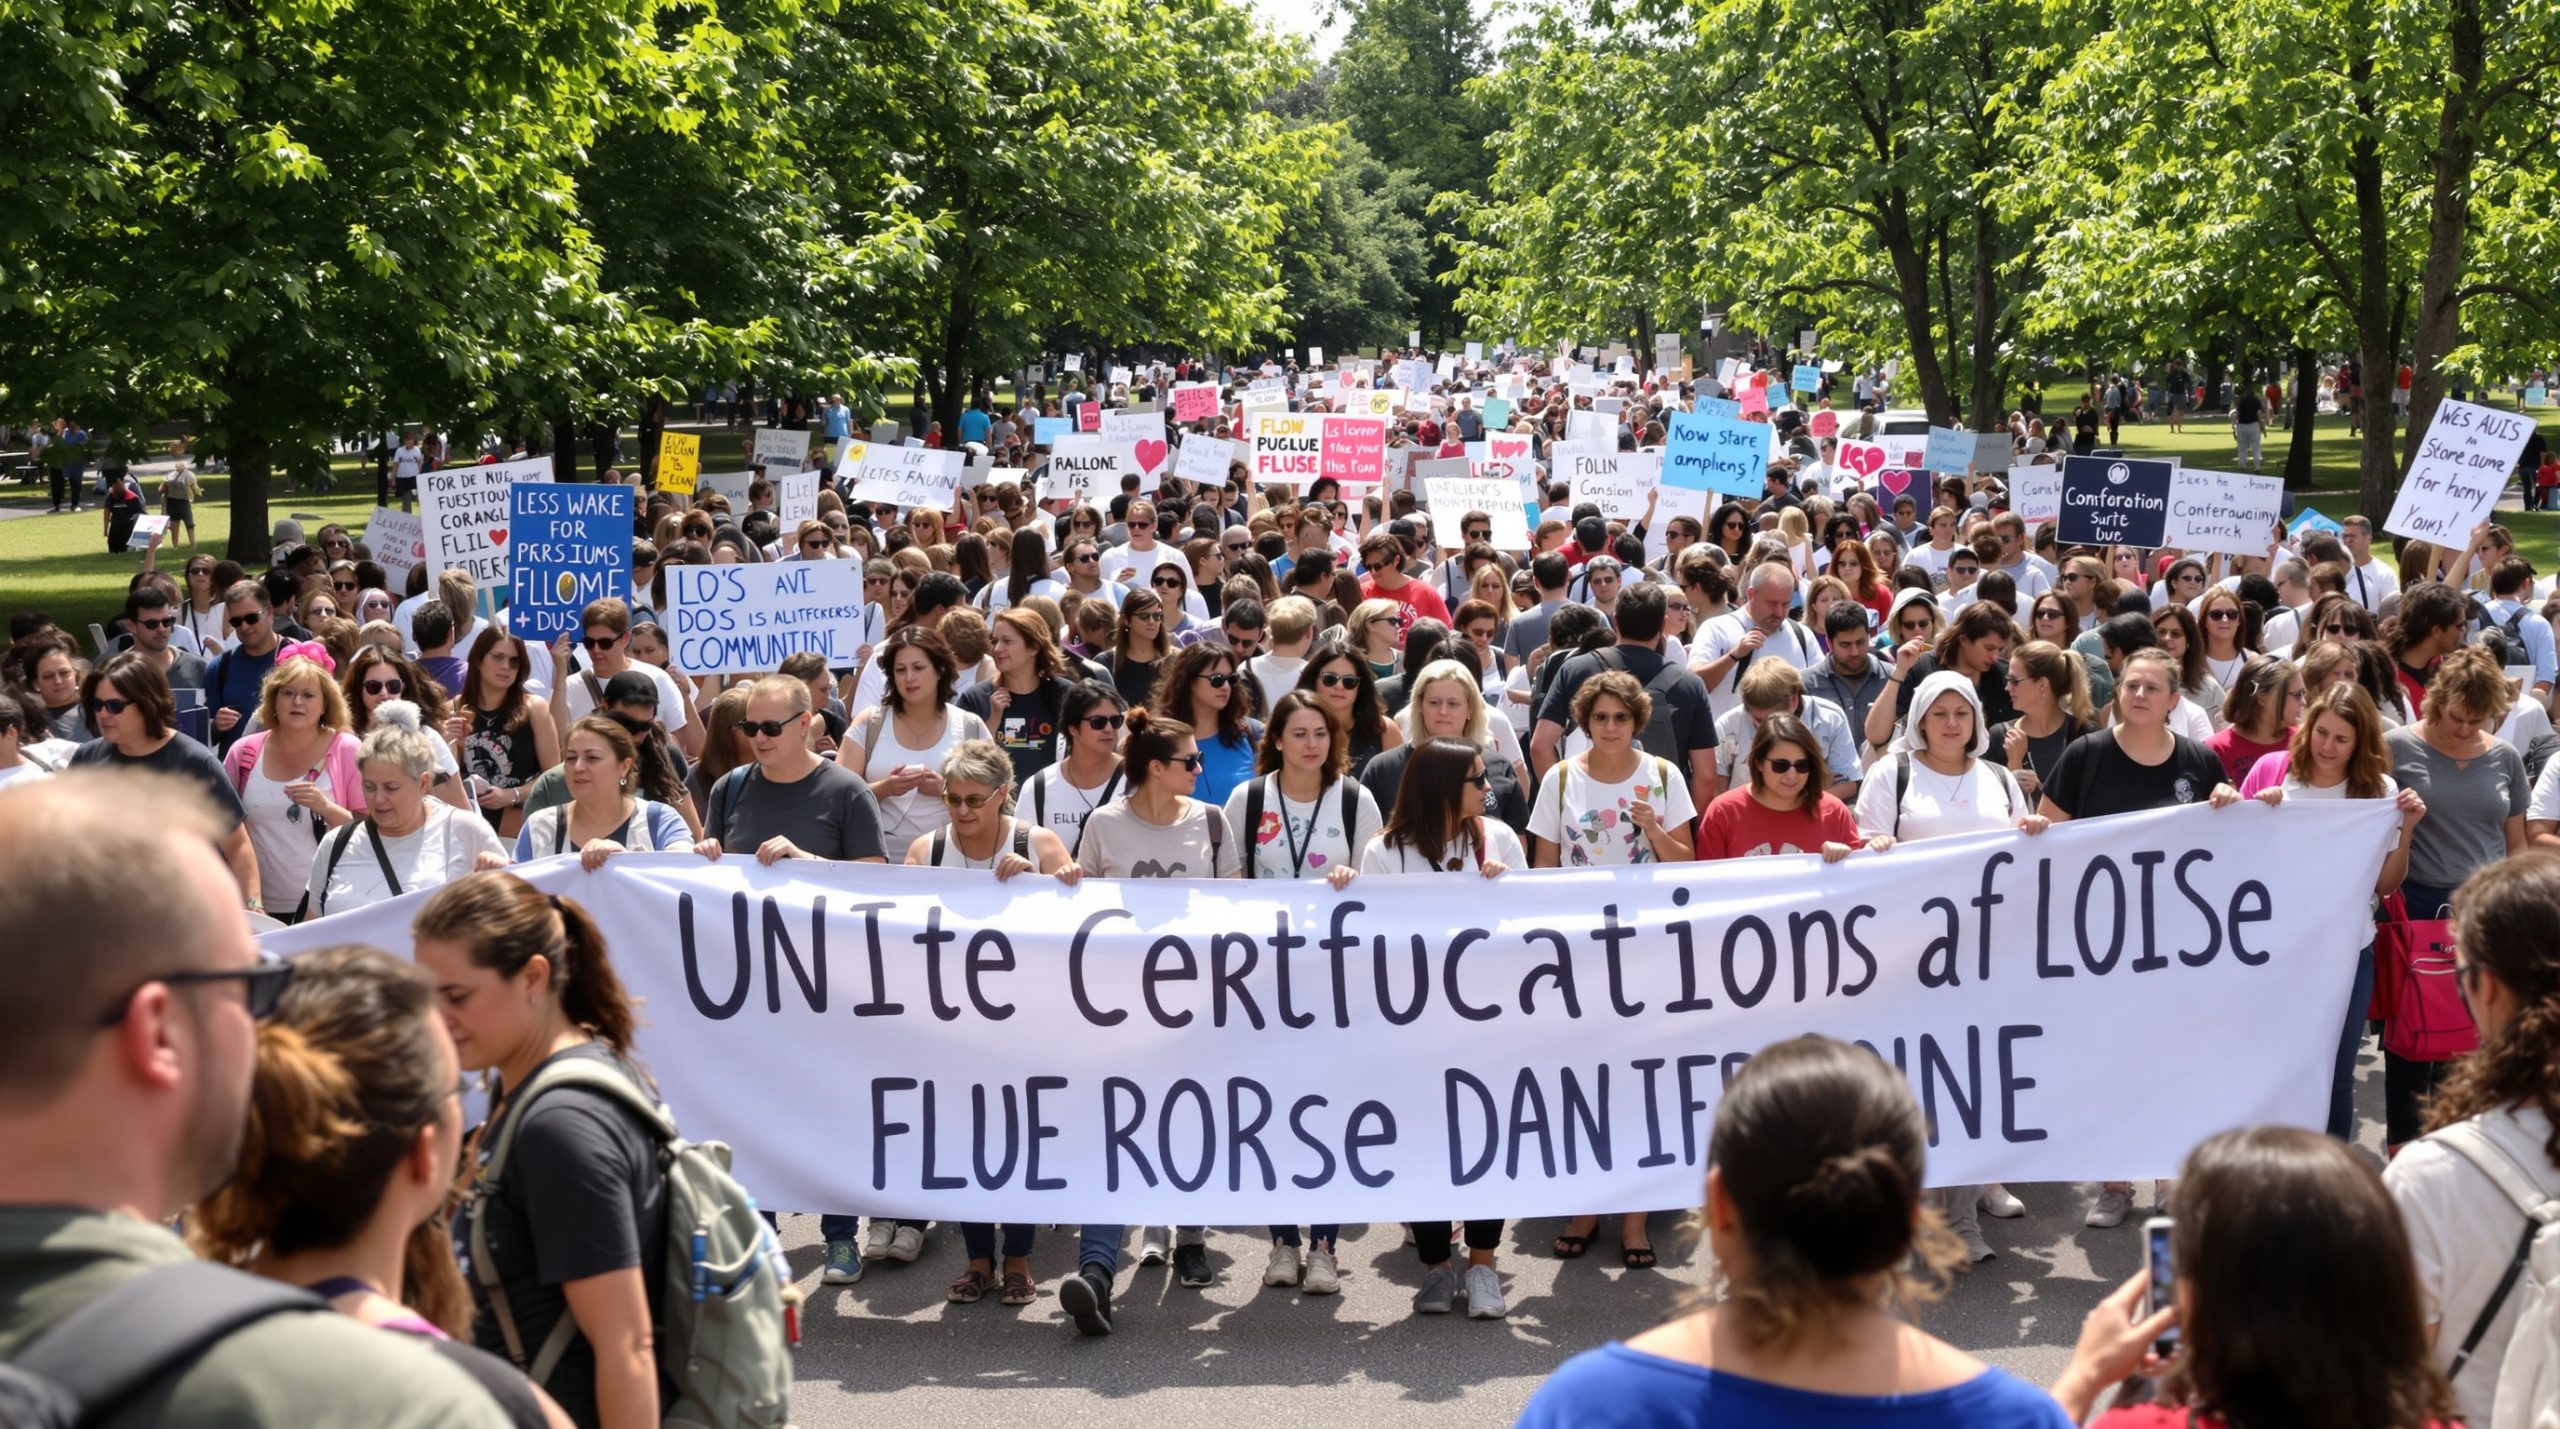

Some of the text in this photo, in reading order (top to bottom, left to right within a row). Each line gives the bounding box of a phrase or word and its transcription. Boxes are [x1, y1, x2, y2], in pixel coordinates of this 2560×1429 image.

[1260, 417, 1305, 436] FLOW
[1257, 437, 1319, 453] PUGLUE
[1258, 455, 1318, 474] FLUSE
[428, 476, 457, 492] FOR
[517, 491, 625, 517] LESS WAKE
[550, 520, 588, 540] FOR
[678, 567, 746, 606] LO'S
[678, 608, 736, 634] DOS
[749, 612, 767, 627] IS
[871, 1075, 1069, 1192] FLUE
